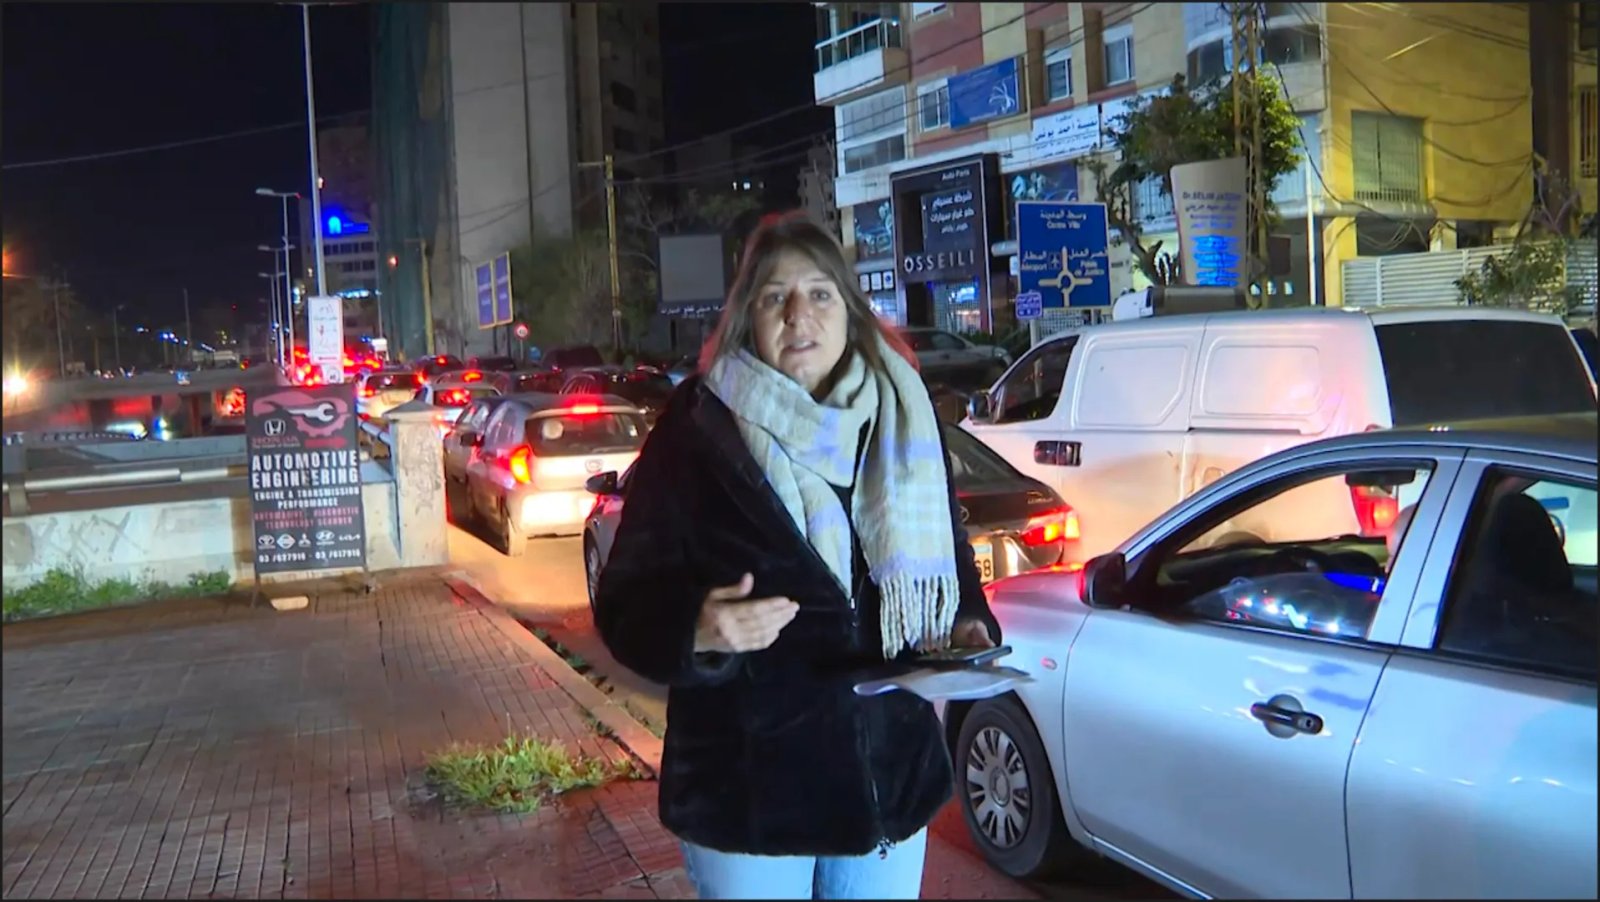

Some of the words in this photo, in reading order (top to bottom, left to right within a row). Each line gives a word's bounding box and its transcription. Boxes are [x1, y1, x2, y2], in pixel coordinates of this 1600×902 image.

[1040, 209, 1065, 221] المدينة
[1067, 209, 1087, 221] وسط
[1023, 250, 1048, 262] المطار
[1069, 247, 1090, 260] العدل
[252, 450, 358, 471] AUTOMOTIVE
[251, 467, 358, 489] ENGINEERING
[254, 490, 285, 501] ENGINE
[297, 486, 360, 499] TRANSMISSION
[277, 497, 339, 510] PERFORMANCE
[258, 554, 270, 563] 03
[315, 551, 326, 560] 03
